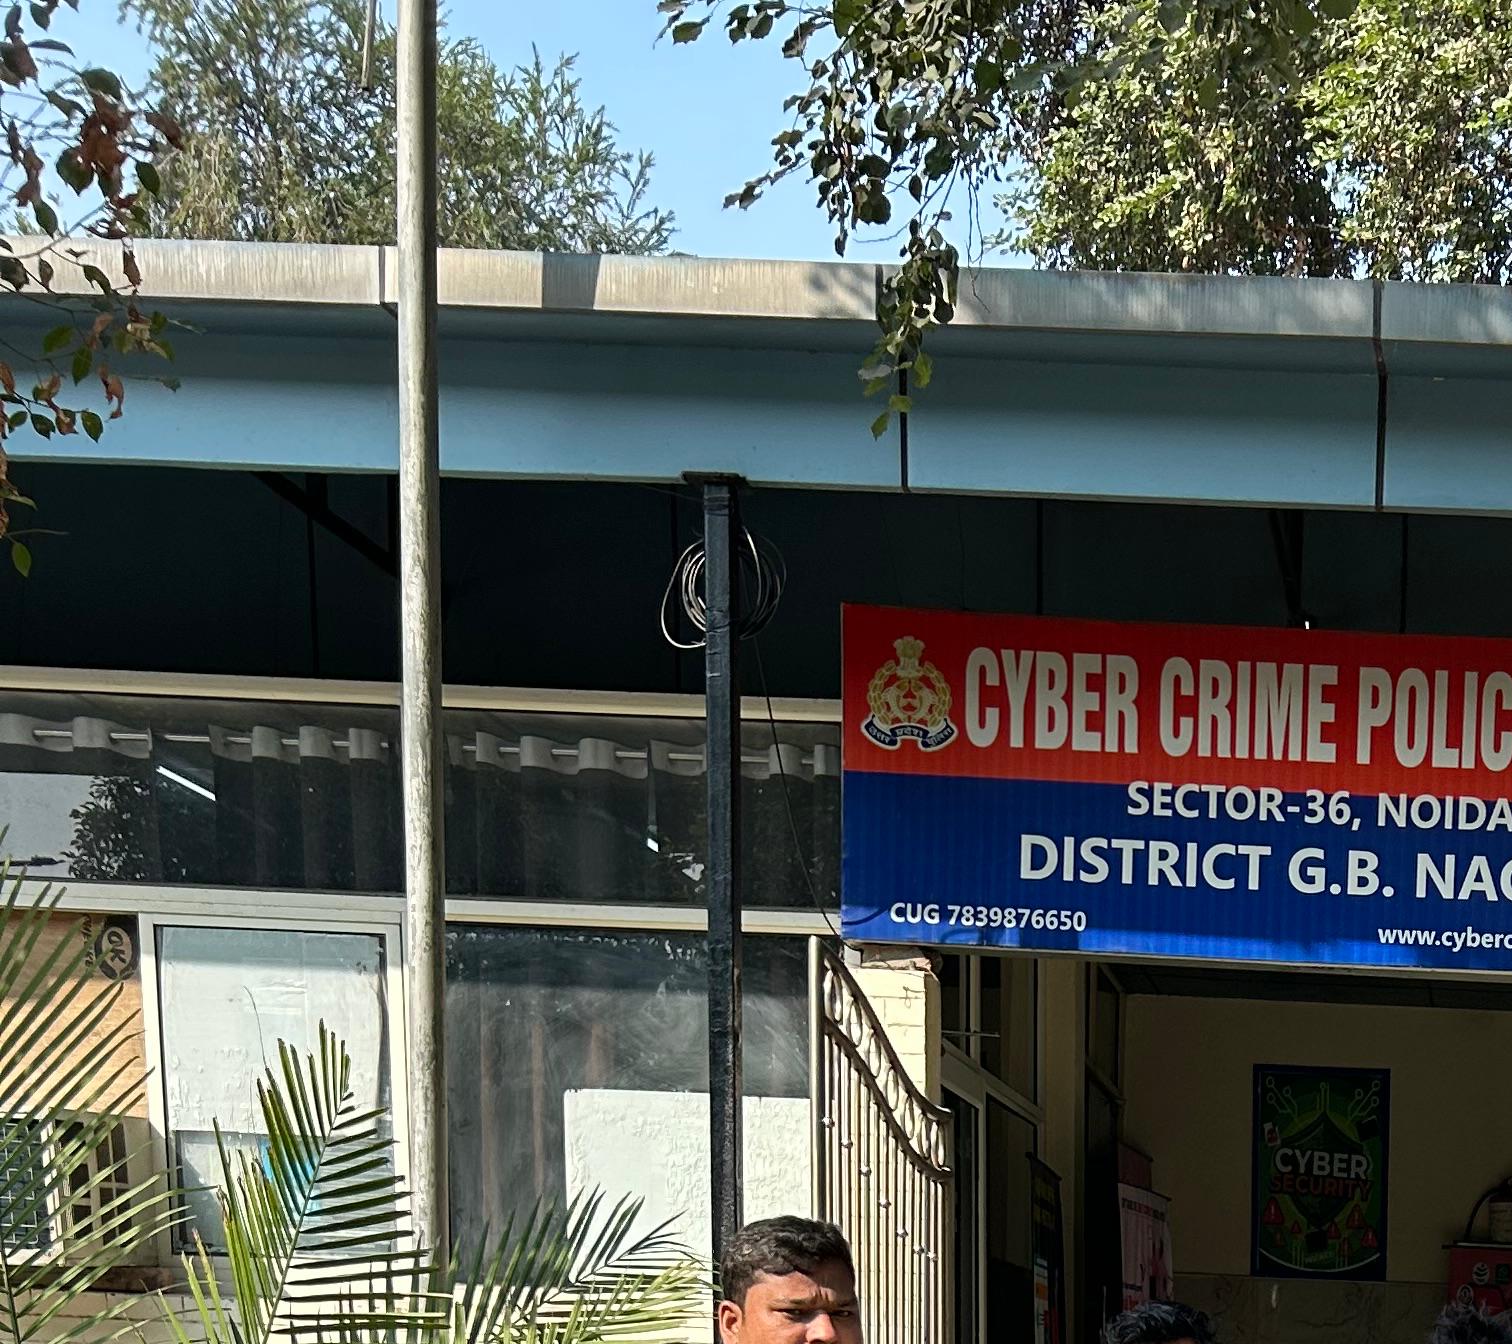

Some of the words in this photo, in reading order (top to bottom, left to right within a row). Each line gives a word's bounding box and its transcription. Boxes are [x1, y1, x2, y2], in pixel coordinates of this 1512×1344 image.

[965, 646, 1139, 754] CYBER
[1159, 656, 1339, 764] CRIME
[1127, 782, 1361, 832] SECTOR-36,
[1019, 834, 1272, 891] DISTRICT
[1288, 848, 1395, 898] G.B.
[889, 902, 941, 926] CUG
[947, 904, 1087, 934] 7839876650
[1275, 1147, 1369, 1179] CYBER
[1269, 1173, 1373, 1202] SECURITY
